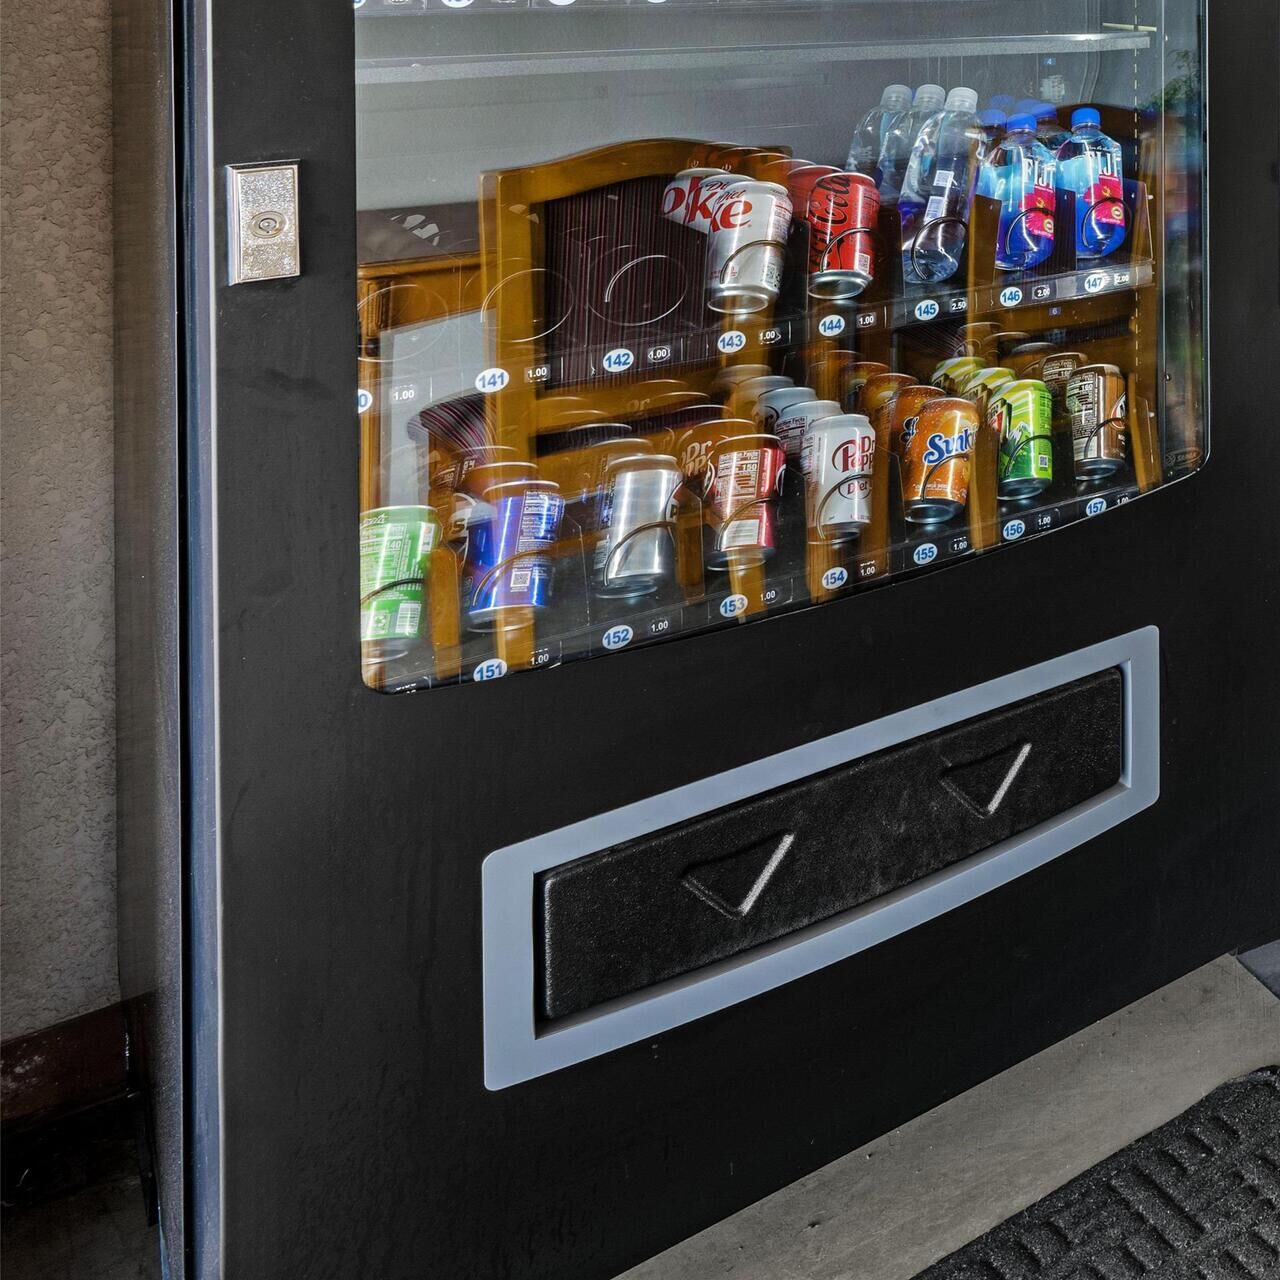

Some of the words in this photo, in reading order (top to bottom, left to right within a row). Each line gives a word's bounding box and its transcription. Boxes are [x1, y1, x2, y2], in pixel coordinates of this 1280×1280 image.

[716, 189, 747, 205] Diet
[1086, 278, 1102, 291] 147
[1001, 290, 1021, 303] 146
[916, 303, 937, 317] 145
[951, 301, 967, 310] 2.50
[820, 317, 843, 332] 144
[859, 315, 874, 325] 1.00
[719, 334, 743, 349] 143
[759, 331, 775, 341] 1.00
[605, 353, 631, 368] 142
[649, 349, 667, 359] 1.00
[478, 373, 506, 389] 141
[527, 367, 547, 378] 1.00
[393, 389, 415, 401] 1.00
[1087, 501, 1105, 515] 157
[1004, 523, 1024, 537] 156
[1038, 516, 1051, 526] 1.00
[915, 548, 935, 561] 155
[953, 541, 968, 551] 1.00
[824, 571, 846, 585] 154
[860, 566, 875, 576] 1.00
[721, 598, 745, 614] 153
[760, 590, 776, 601] 1.00
[605, 630, 631, 646] 152
[651, 620, 669, 632] 1.00
[476, 666, 504, 680] 151
[530, 654, 549, 665] 1.00
